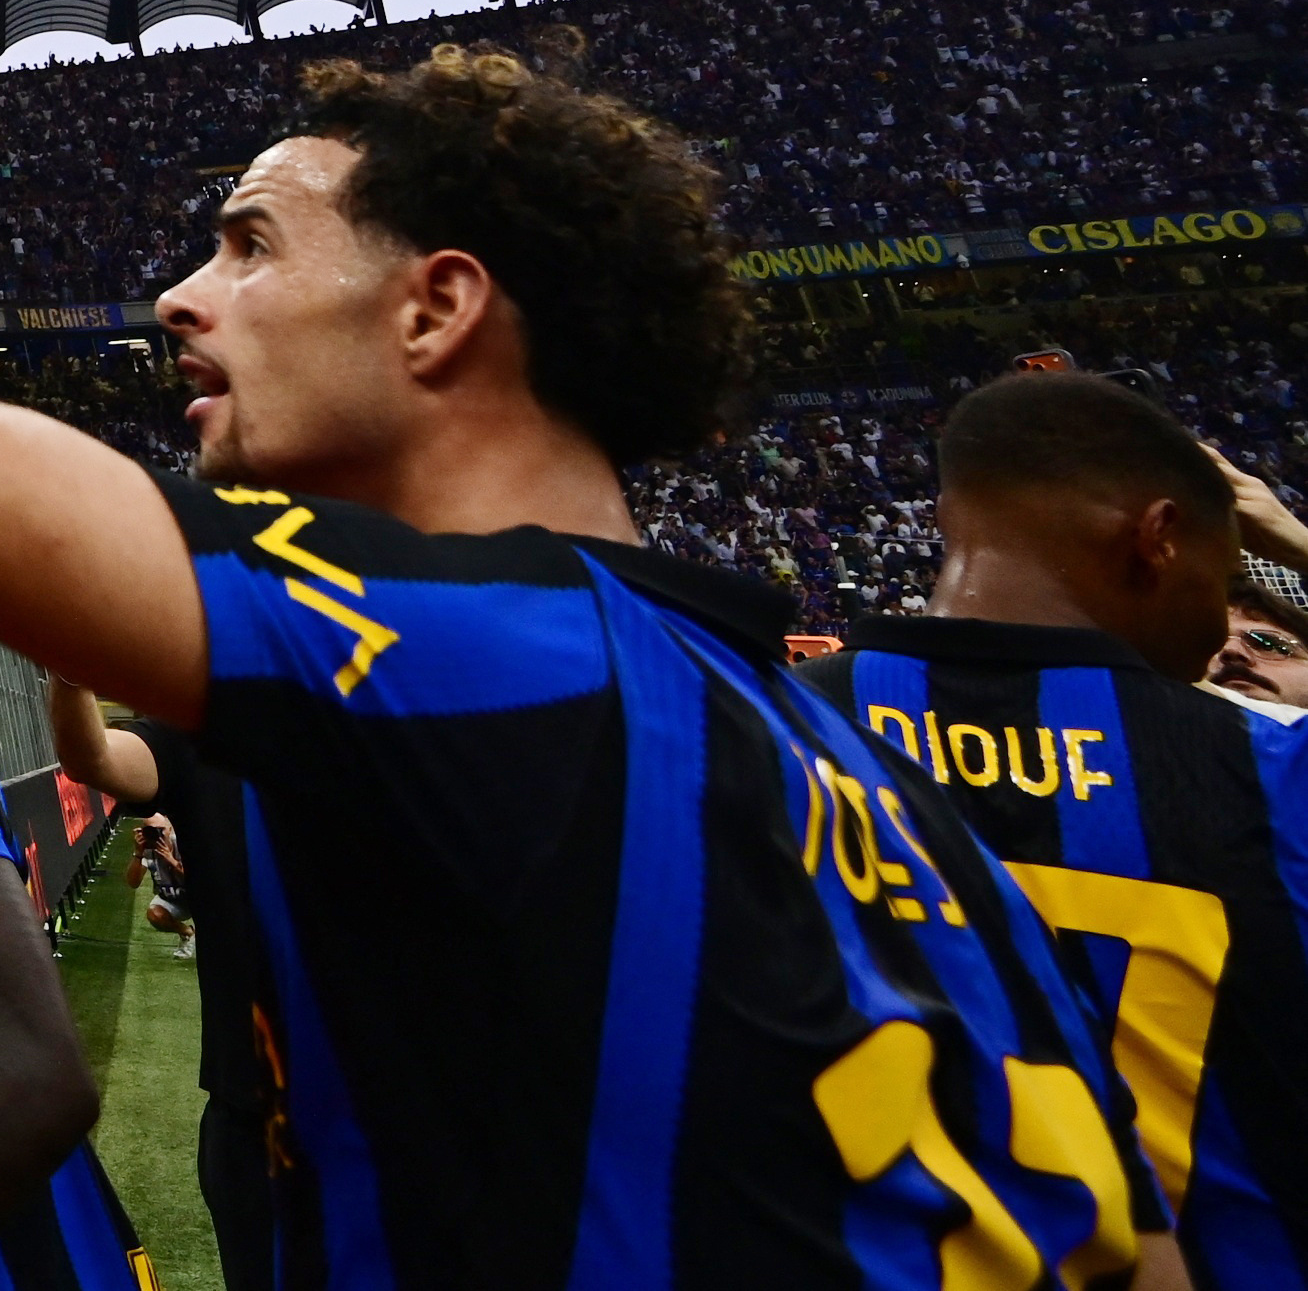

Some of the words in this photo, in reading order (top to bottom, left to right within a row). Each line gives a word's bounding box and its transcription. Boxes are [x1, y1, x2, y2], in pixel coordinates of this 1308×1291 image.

[1027, 209, 1267, 255] CISLAGO
[730, 234, 942, 280] MONSUMMANO
[16, 307, 111, 329] VALCHIESE
[867, 704, 1114, 801] DIOUF
